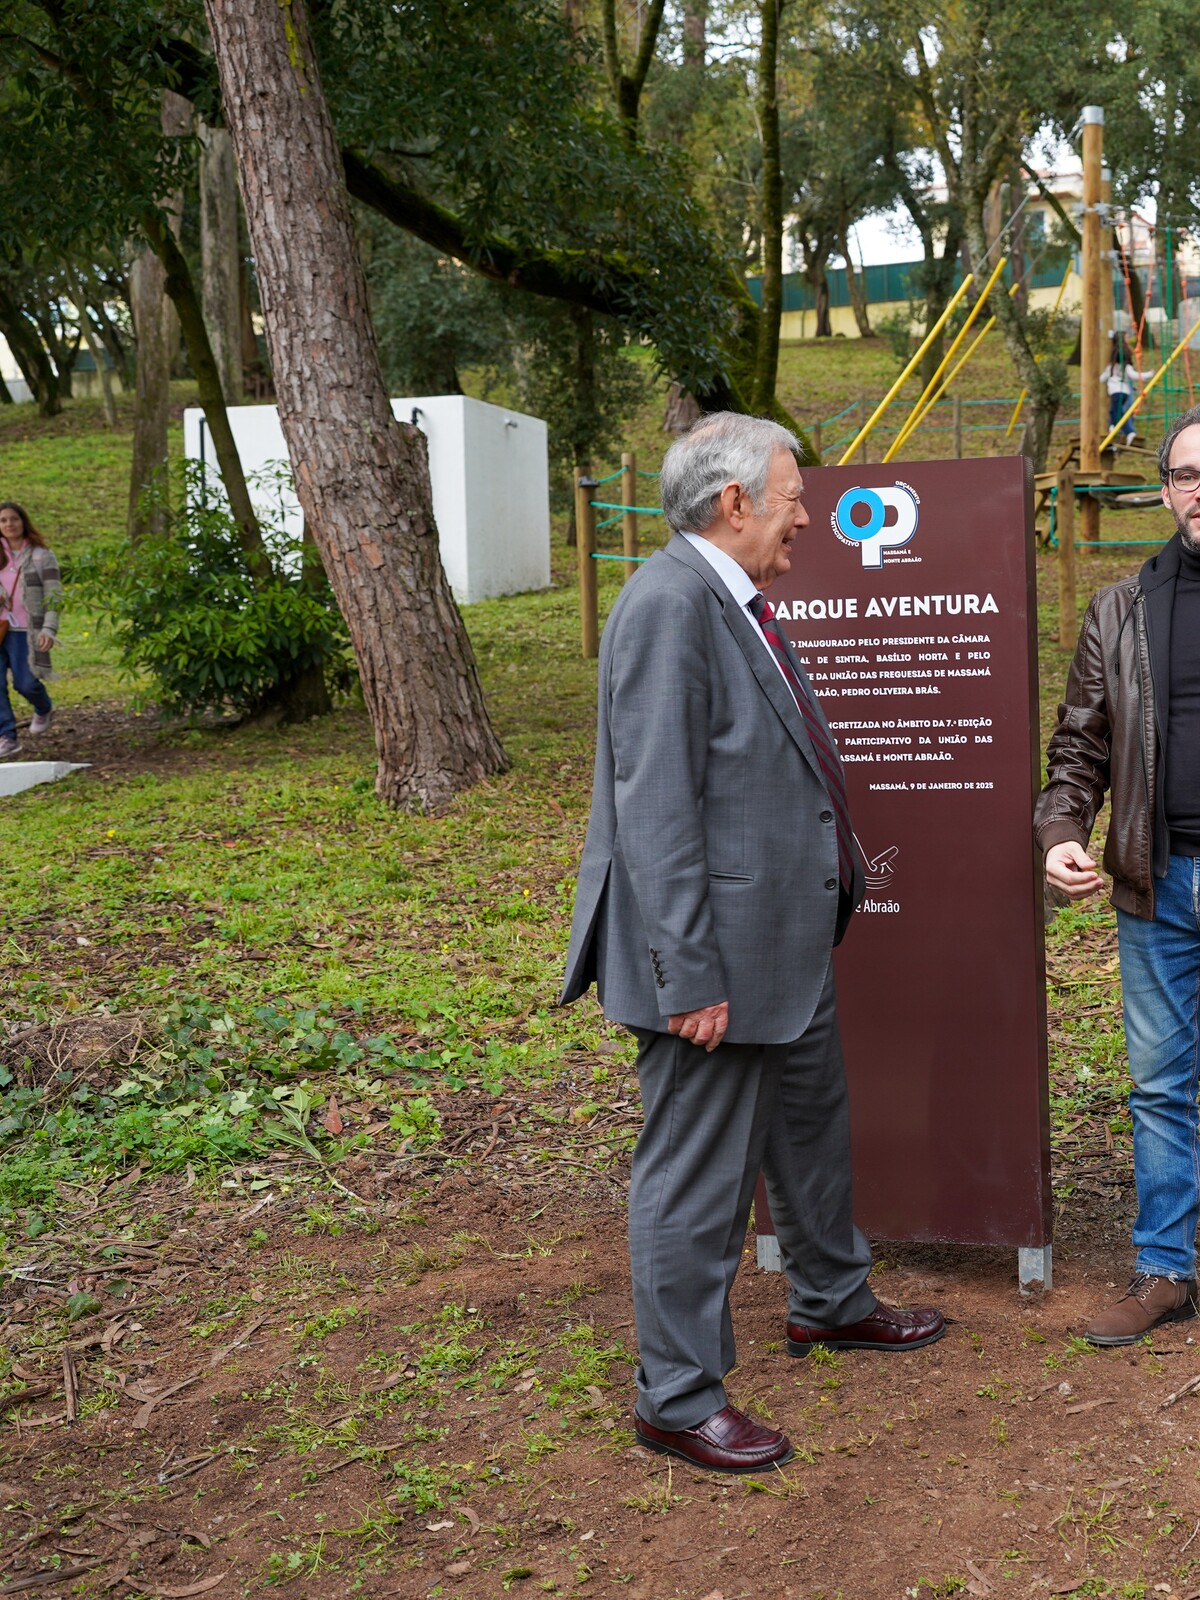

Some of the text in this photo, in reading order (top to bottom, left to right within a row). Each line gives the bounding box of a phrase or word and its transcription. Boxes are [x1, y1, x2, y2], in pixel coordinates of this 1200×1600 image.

[895, 480, 921, 505] ORÇAMENTO
[830, 511, 860, 547] PARTICIPATIVO
[767, 593, 999, 621] ARQUE AVENTURA
[798, 639, 856, 648] INAUGURADO
[858, 638, 880, 646] PELO
[882, 636, 935, 646] PRESIDENTE
[937, 636, 950, 644] DA
[952, 634, 991, 644] CÂMARA
[817, 656, 829, 664] DE
[835, 655, 870, 664] SINTRA,
[876, 652, 912, 662] BASÍLIO
[918, 653, 949, 661] HORTA
[955, 652, 961, 660] E
[968, 651, 991, 660] PELO
[830, 670, 858, 680] UNIÃO
[860, 671, 878, 679] DAS
[879, 670, 933, 679] FREGUESIAS
[934, 669, 946, 677] DE
[947, 666, 991, 677] MASSAMÁ
[841, 688, 871, 696] PEDRO
[872, 687, 914, 696] OLIVEIRA
[915, 684, 941, 695] BRÁS.
[882, 720, 896, 728] NO
[896, 718, 931, 728] ÂMBITO
[958, 717, 993, 729] EDIÇÃO
[845, 737, 912, 746] PARTICIPATIVO
[919, 736, 932, 744] DA
[938, 734, 968, 744] UNIÃO
[975, 735, 993, 743] DAS
[876, 754, 881, 762] E
[883, 753, 913, 761] MONTE
[914, 751, 954, 761] ABRAÃO.
[869, 781, 909, 791] MASSAMÁ,
[928, 782, 963, 790] JANEIRO
[863, 899, 900, 913] Abraão
